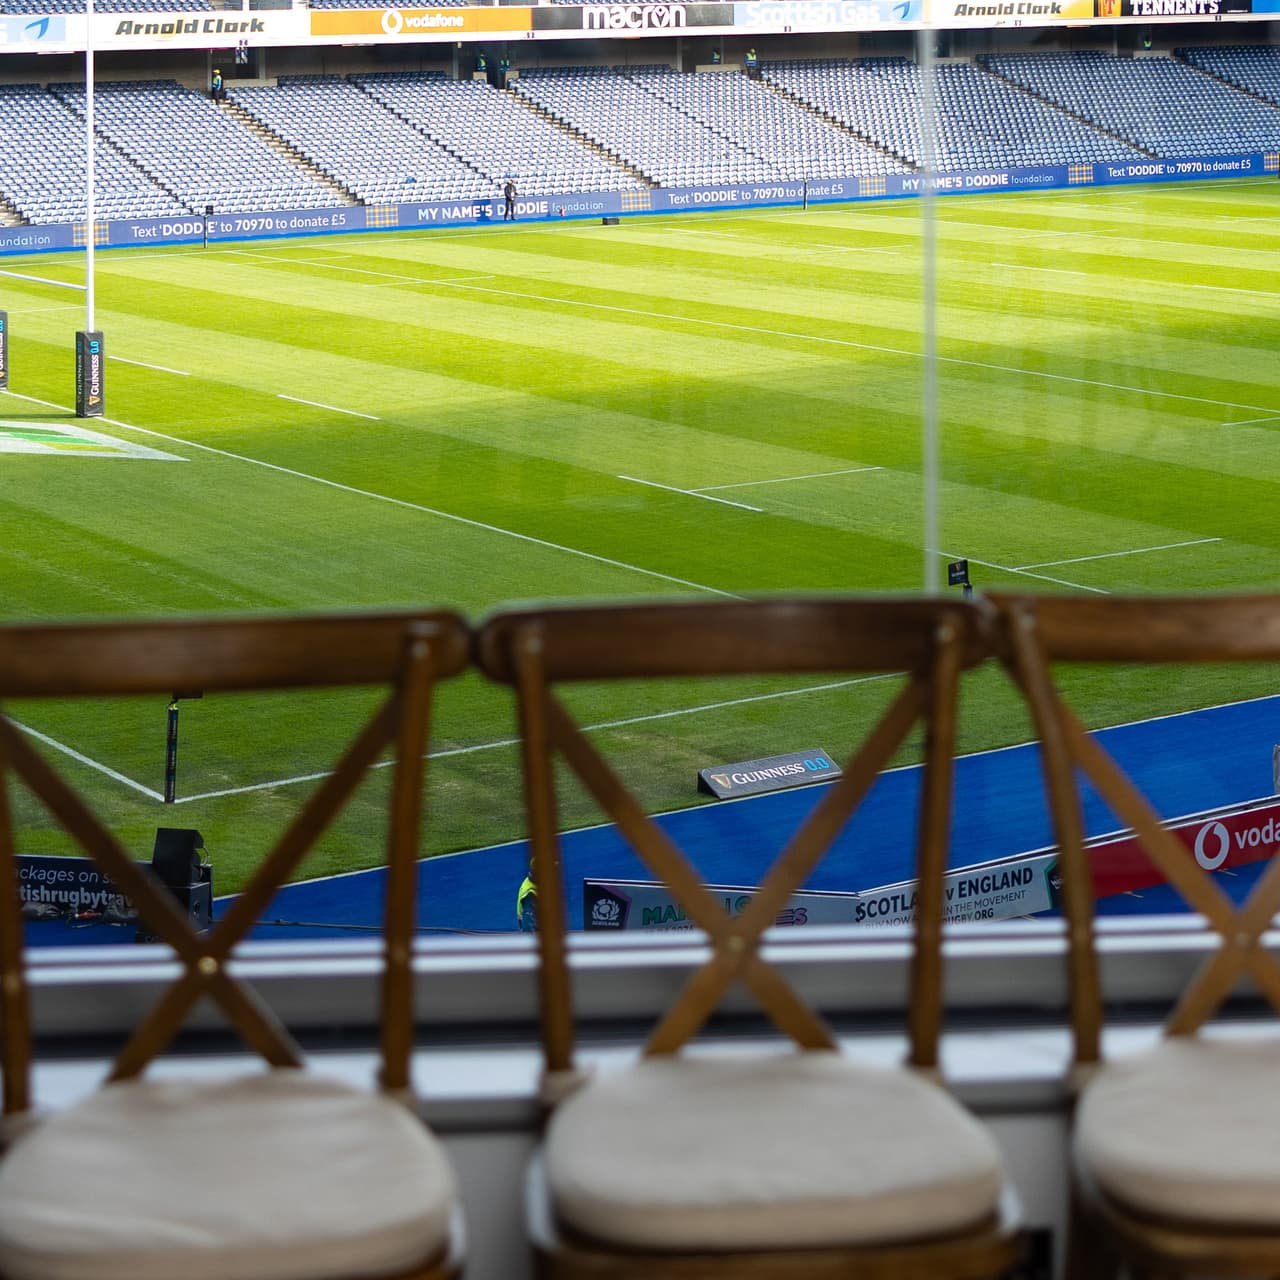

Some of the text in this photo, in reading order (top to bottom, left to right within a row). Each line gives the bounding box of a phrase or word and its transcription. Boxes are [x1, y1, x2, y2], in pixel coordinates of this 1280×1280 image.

[581, 4, 687, 30] macron
[745, 1, 881, 26] Scottish Gas
[953, 0, 1062, 17] Arnold Clark
[115, 17, 266, 36] Arnold Clark
[405, 13, 465, 29] vodafone
[1107, 166, 1126, 178] Text
[1166, 162, 1176, 174] to
[1176, 161, 1202, 174] 70970
[1203, 160, 1212, 172] to
[1212, 159, 1240, 172] donate
[1240, 158, 1252, 170] £5
[902, 177, 920, 192] MY
[965, 173, 1009, 188] DODDIE
[1010, 171, 1055, 185] foundation
[668, 192, 690, 206] Text
[741, 188, 752, 201] to
[752, 186, 785, 201] 70970
[785, 185, 797, 199] to
[831, 182, 844, 196] £5
[418, 207, 438, 222] MY
[497, 200, 549, 218] DDDIE
[551, 200, 604, 214] foundation
[131, 224, 157, 239] Text
[220, 219, 233, 233] to
[235, 217, 274, 233] 70970
[275, 216, 289, 231] to
[289, 214, 330, 229] donate
[331, 212, 347, 227] £5
[89, 354, 101, 396] GUINNESS
[731, 757, 831, 785] GUINNESS 0.0
[78, 871, 98, 884] on
[957, 867, 1034, 899] ENGLAND
[954, 901, 972, 914] THE
[973, 890, 1027, 910] MOVEMENT
